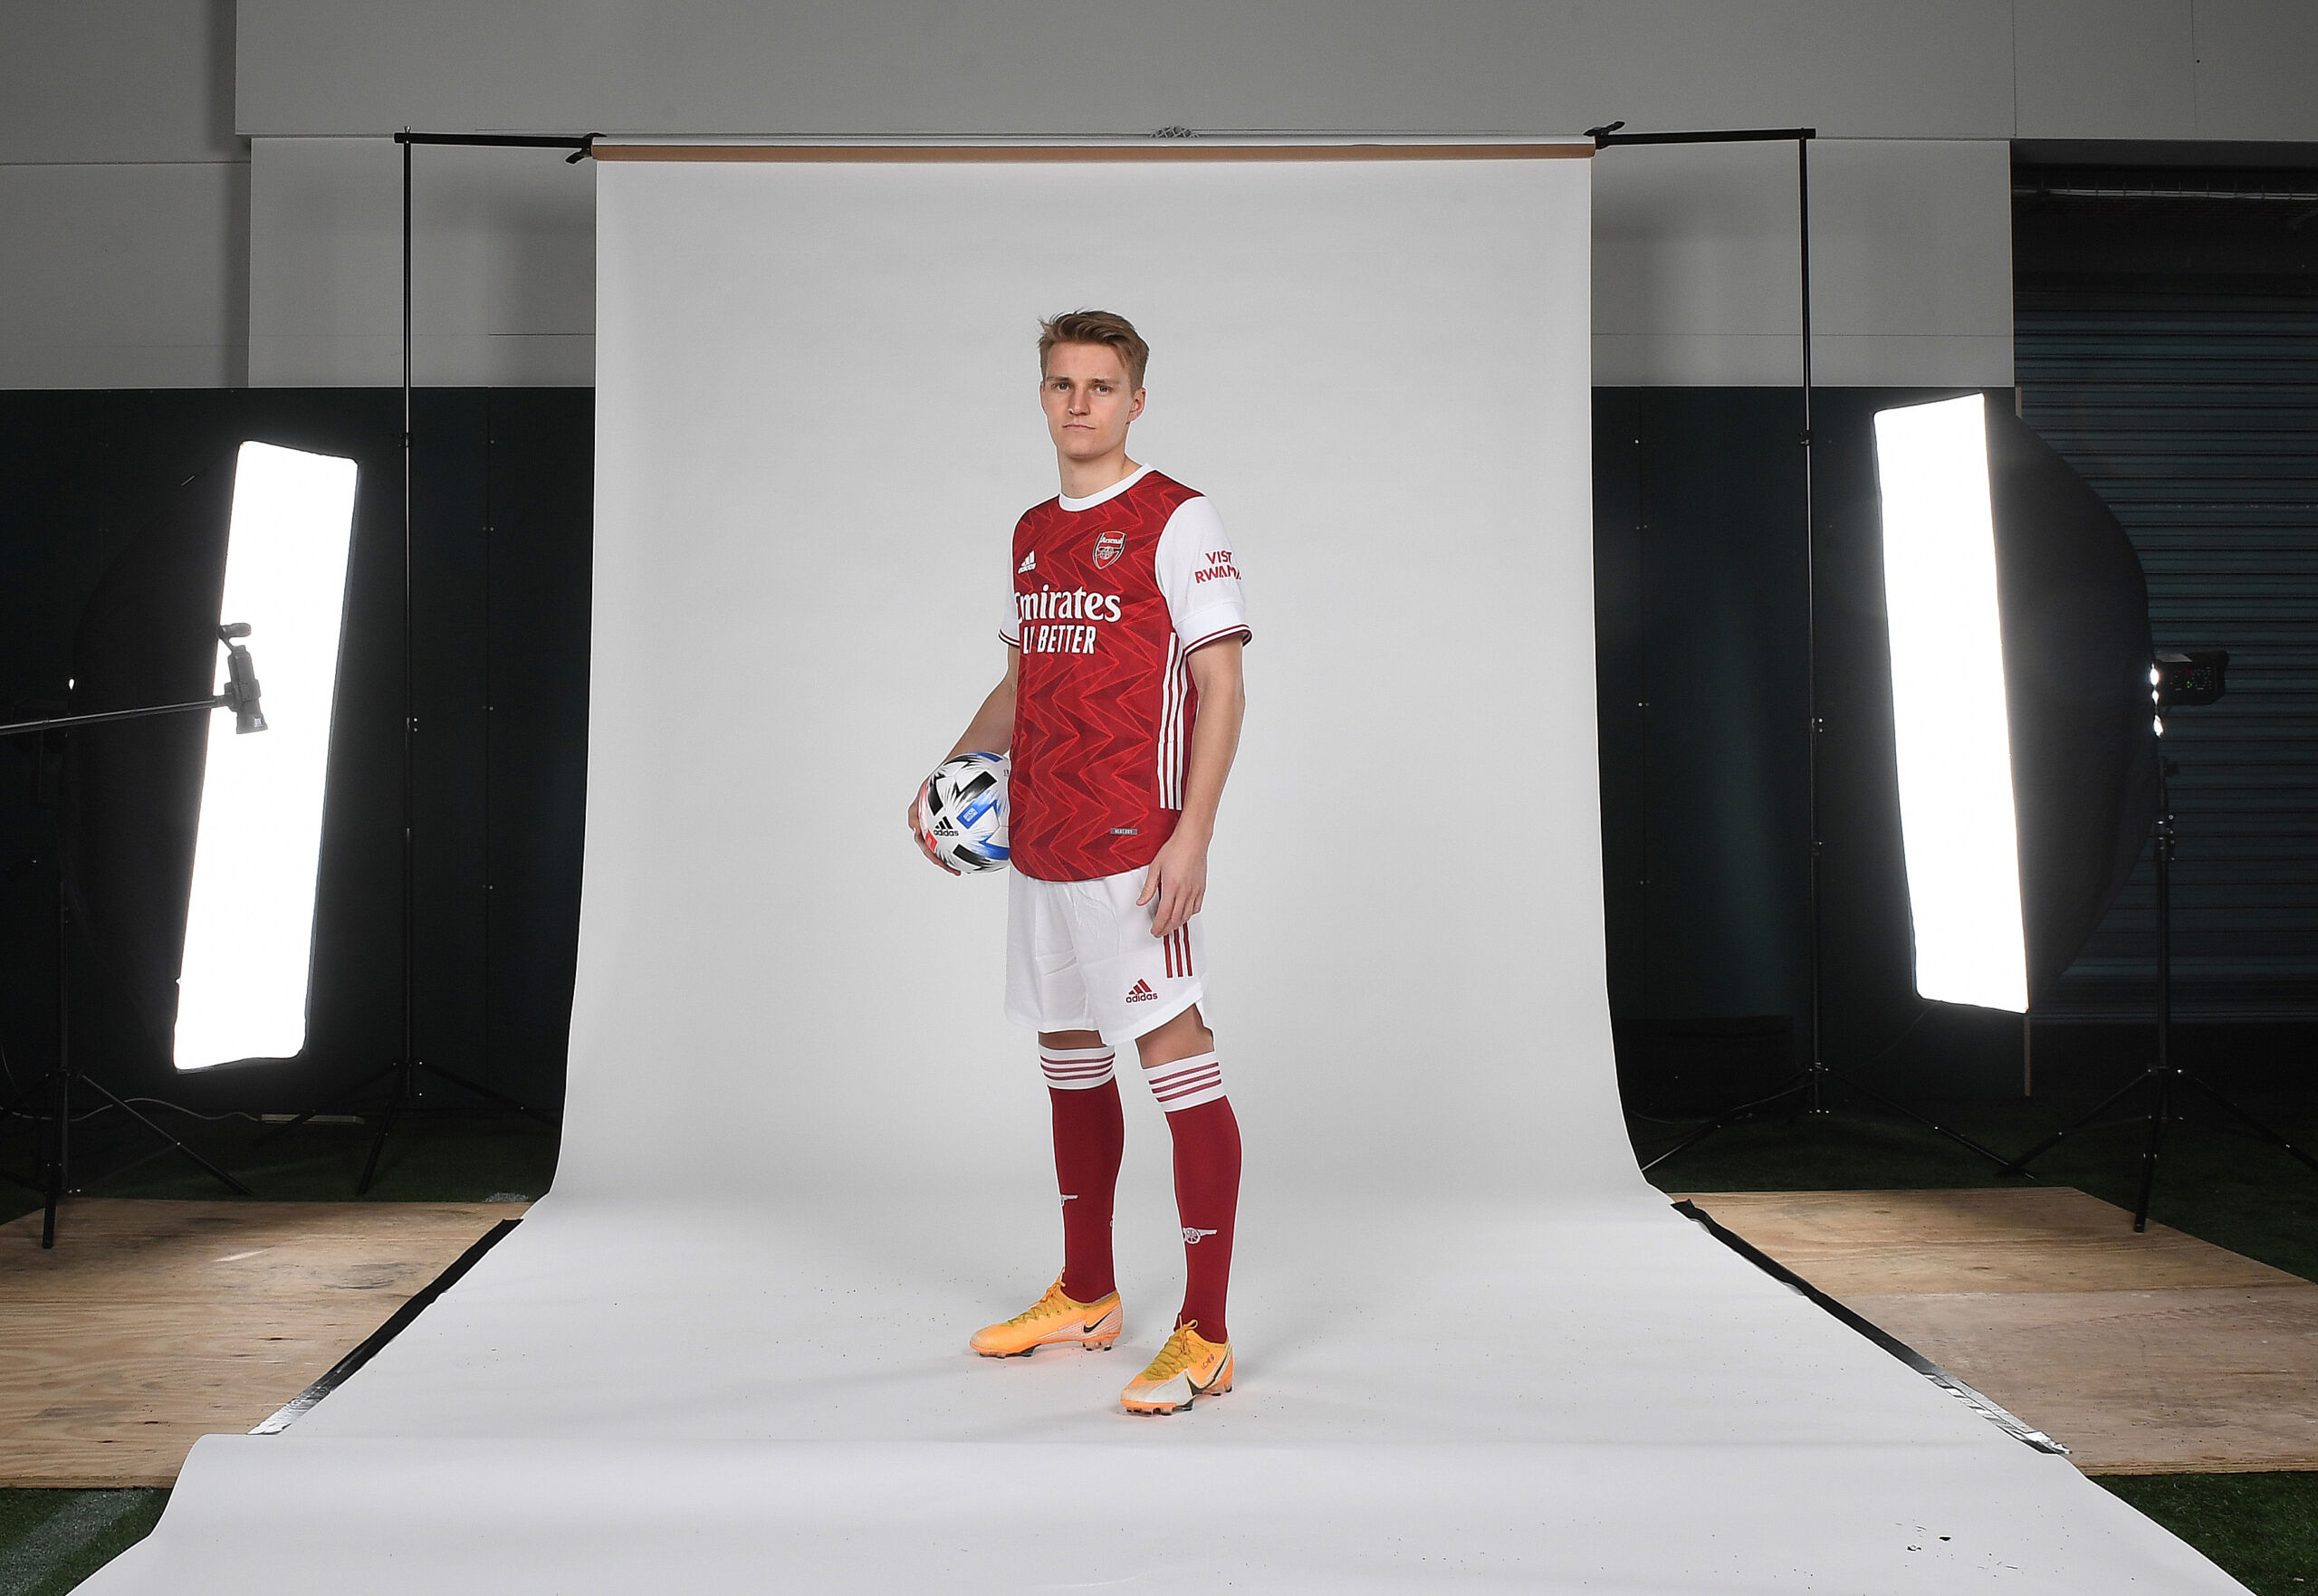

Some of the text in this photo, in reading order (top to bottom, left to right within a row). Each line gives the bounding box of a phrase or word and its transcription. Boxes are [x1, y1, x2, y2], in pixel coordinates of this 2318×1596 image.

[1205, 550, 1231, 564] VIST
[1037, 625, 1097, 654] BETTER
[1125, 992, 1158, 1003] adidas
